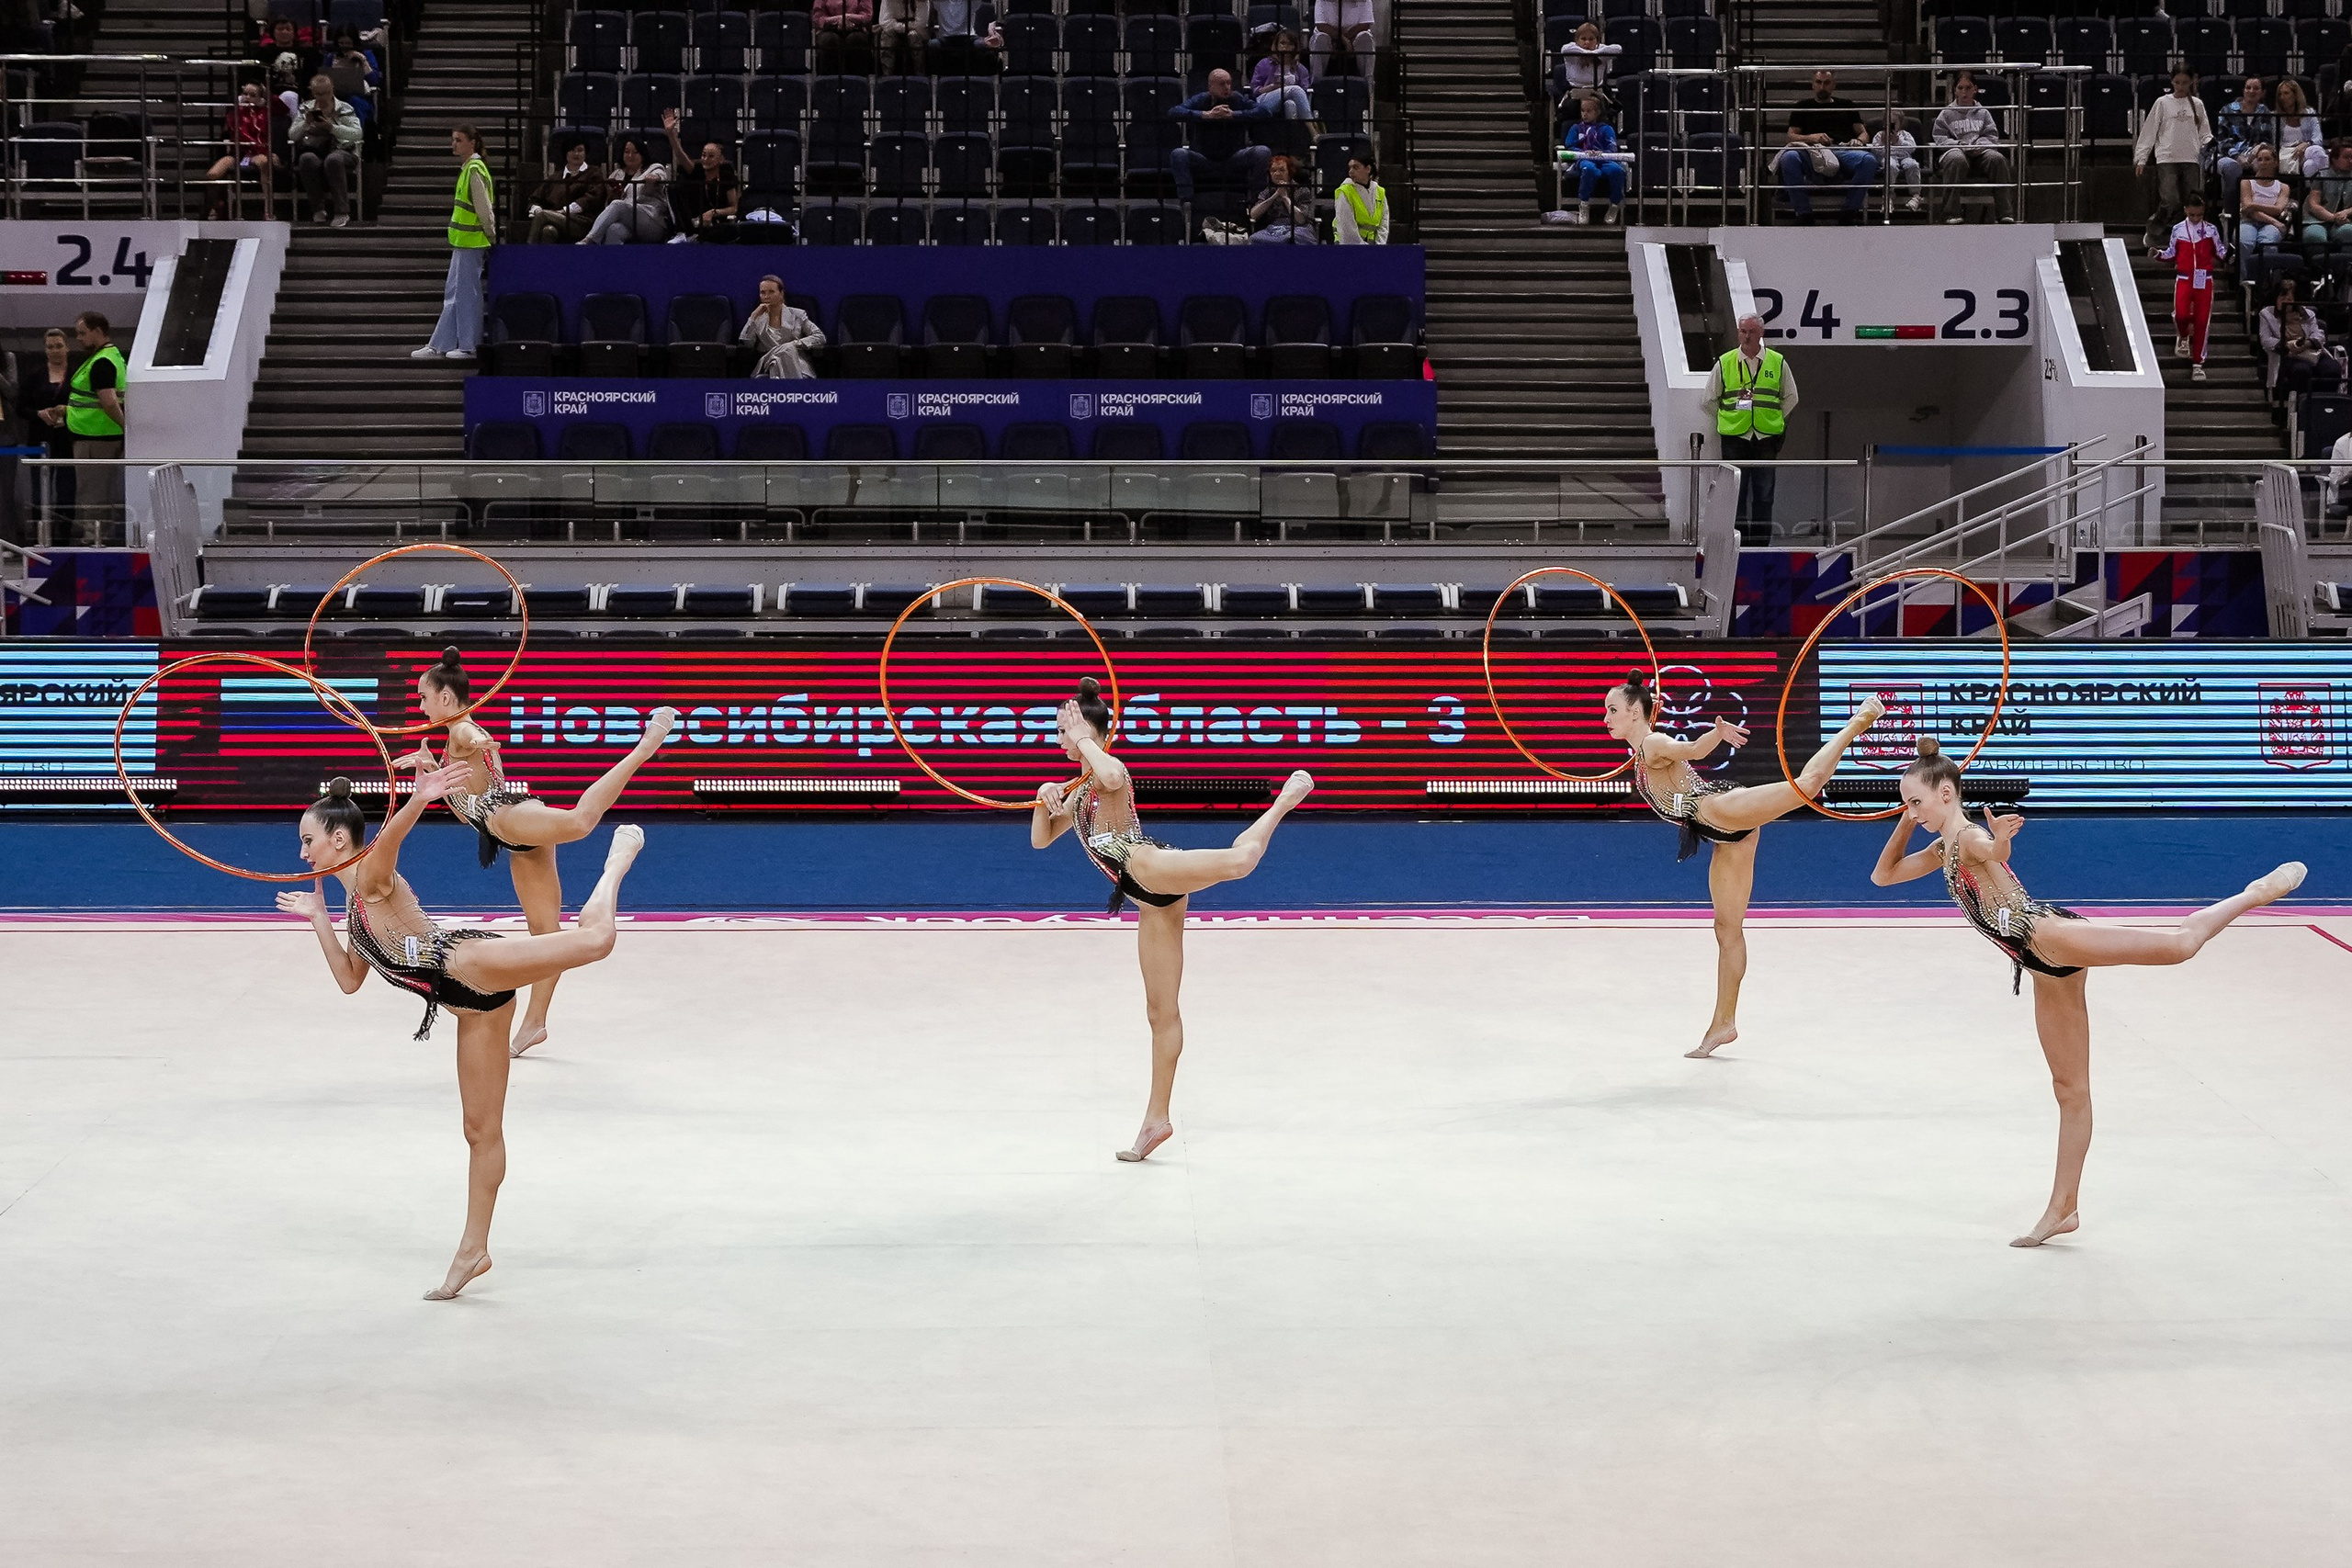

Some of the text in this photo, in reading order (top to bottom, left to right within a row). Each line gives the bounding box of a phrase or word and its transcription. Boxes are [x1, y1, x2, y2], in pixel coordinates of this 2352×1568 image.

[57, 234, 153, 288] 2.4
[1752, 288, 1840, 339] 2.4
[1940, 288, 2030, 340] 2.3
[1764, 369, 1774, 378] 86
[554, 390, 656, 402] КРАСНОЯРСКИЙ
[736, 391, 838, 403] КРАСНОЯРСКИЙ
[918, 392, 1020, 404] КРАСНОЯРСКИЙ
[1101, 392, 1202, 404] КРАСНОЯРСКИЙ
[1281, 392, 1382, 404] КРАСНОЯРСКИЙ
[554, 402, 586, 414] КРАЙ
[736, 403, 770, 415] КРАЙ
[918, 404, 951, 416] КРАЙ
[1101, 404, 1134, 416] КРАЙ
[1281, 404, 1314, 416] КРАЙ
[1950, 677, 2202, 705] КРАСНОЯРСКИЙ
[1106, 693, 1361, 743] бласть
[1428, 695, 1466, 743] 3
[1951, 708, 2031, 736] КРАЙ
